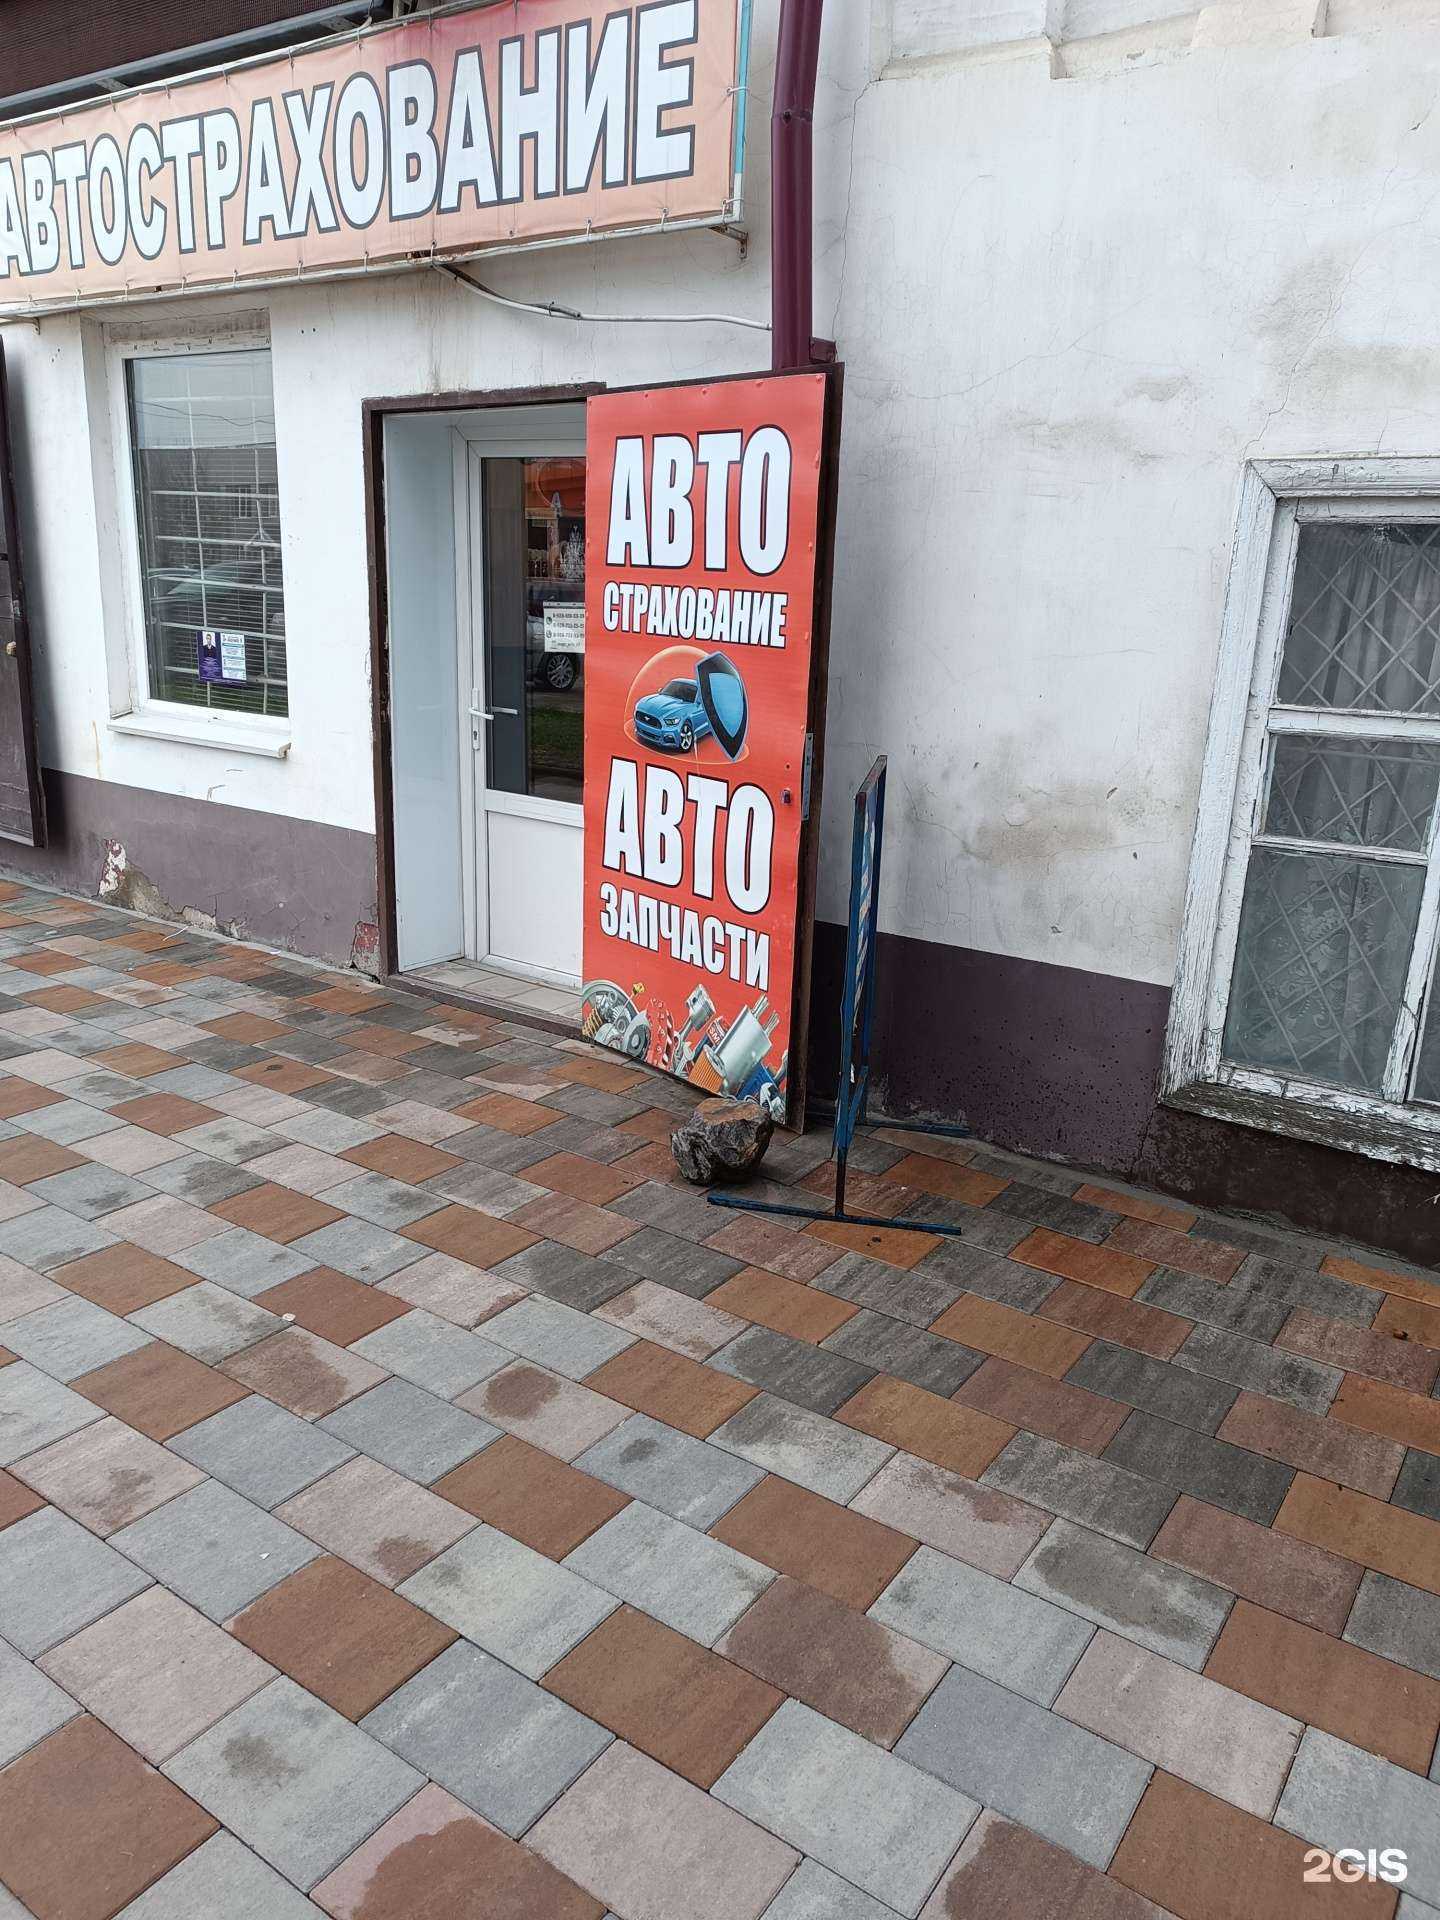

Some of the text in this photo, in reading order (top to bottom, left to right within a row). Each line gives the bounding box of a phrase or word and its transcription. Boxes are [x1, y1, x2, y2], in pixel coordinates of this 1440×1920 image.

[0, 0, 698, 278] АВТОСТРАХОВАНИЕ
[606, 424, 792, 576] АВТО
[603, 580, 788, 649] СТРАХОВАНИЕ
[602, 756, 775, 915] АВТО
[600, 881, 771, 992] ЗАПЧАСТИ
